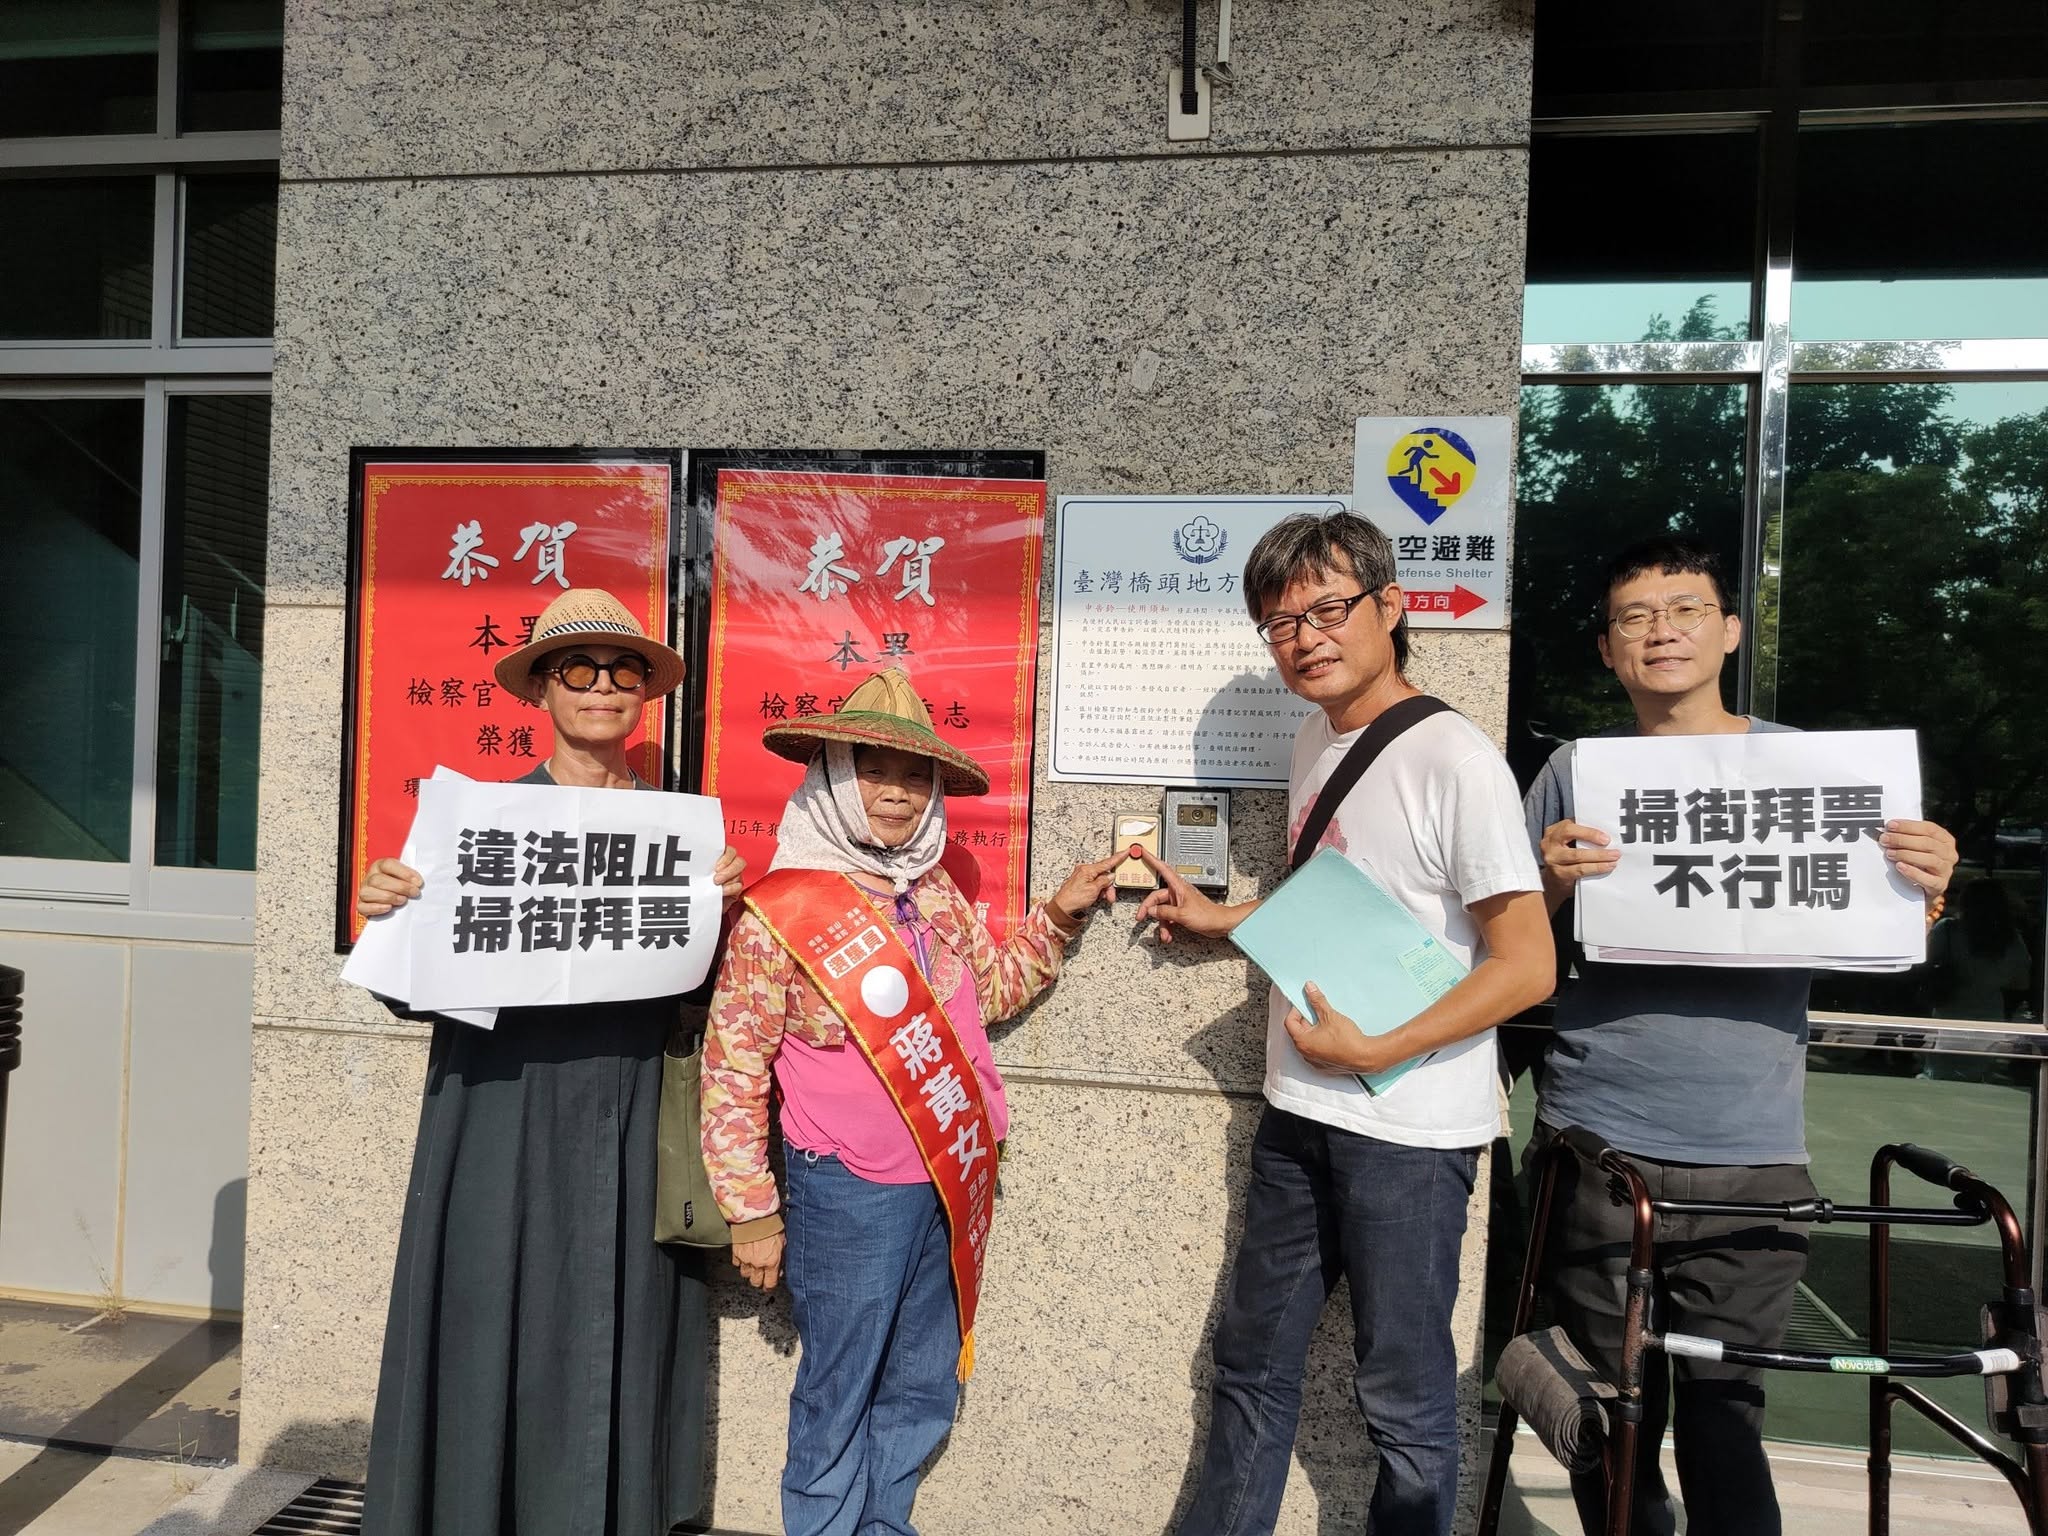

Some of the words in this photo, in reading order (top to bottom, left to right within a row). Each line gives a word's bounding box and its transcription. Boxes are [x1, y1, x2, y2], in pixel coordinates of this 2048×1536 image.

[442, 520, 579, 589] 恭賀
[799, 532, 945, 606] 恭賀
[1387, 535, 1495, 561] 空避難
[1397, 568, 1441, 578] efense
[1446, 568, 1493, 578] Shelter
[1073, 569, 1240, 594] 臺灣橋頭地方
[406, 677, 498, 708] 檢察官
[477, 724, 537, 758] 榮獲
[944, 828, 1008, 847] 務執行
[1619, 785, 1886, 844] 掃街拜票
[457, 829, 691, 887] 違法阻止
[1653, 853, 1851, 910] 不行嗎
[453, 896, 691, 952] 掃街拜票
[889, 1012, 987, 1182] 蔣黃女
